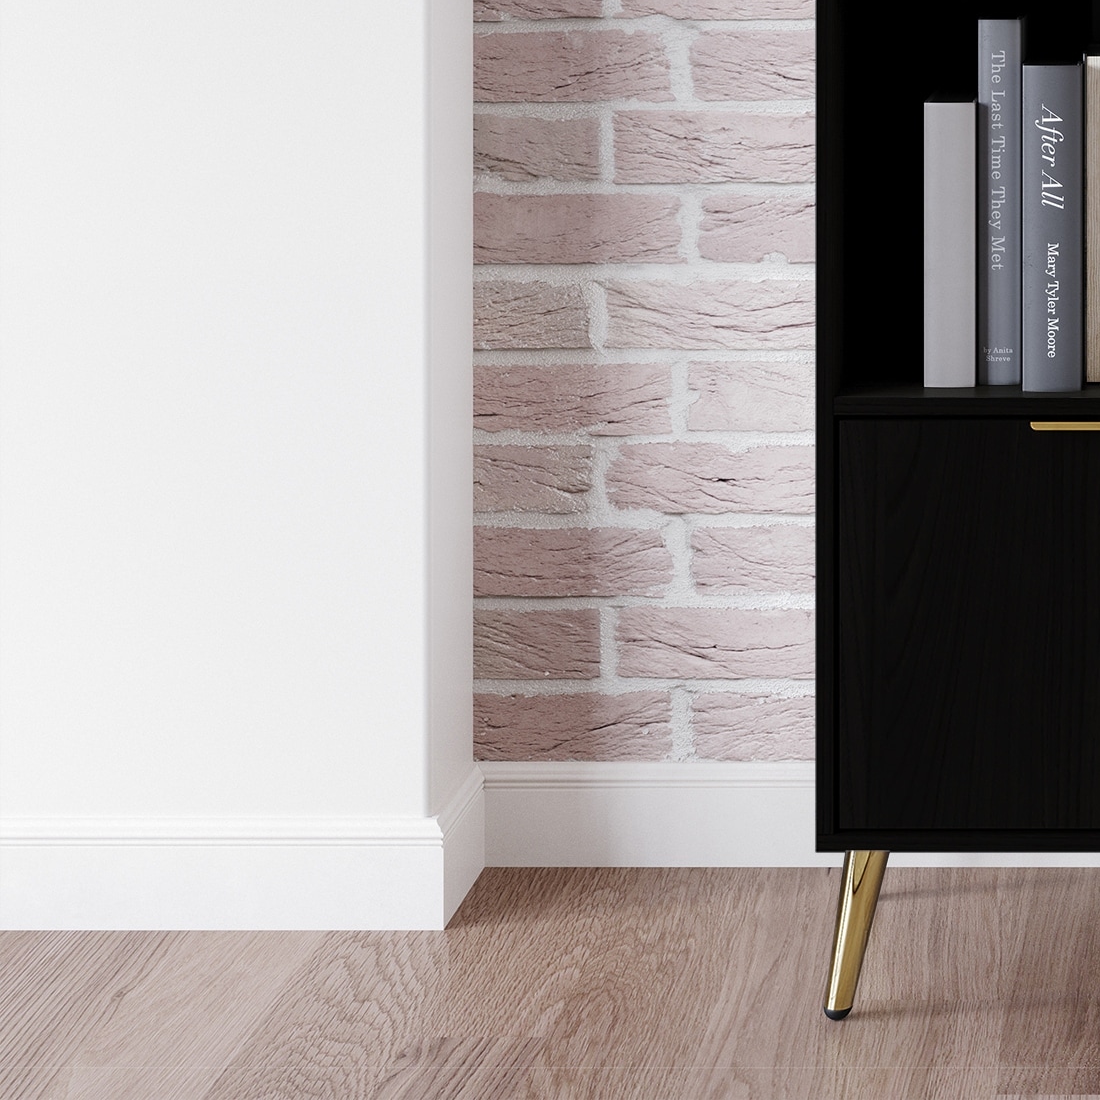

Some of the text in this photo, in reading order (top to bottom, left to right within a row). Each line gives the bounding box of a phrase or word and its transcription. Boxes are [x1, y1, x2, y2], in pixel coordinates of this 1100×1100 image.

[988, 50, 1006, 270] The Last Time They Met
[1034, 103, 1065, 210] After All
[983, 346, 1013, 355] by Anita
[1045, 242, 1060, 359] Mary Tyler Moore
